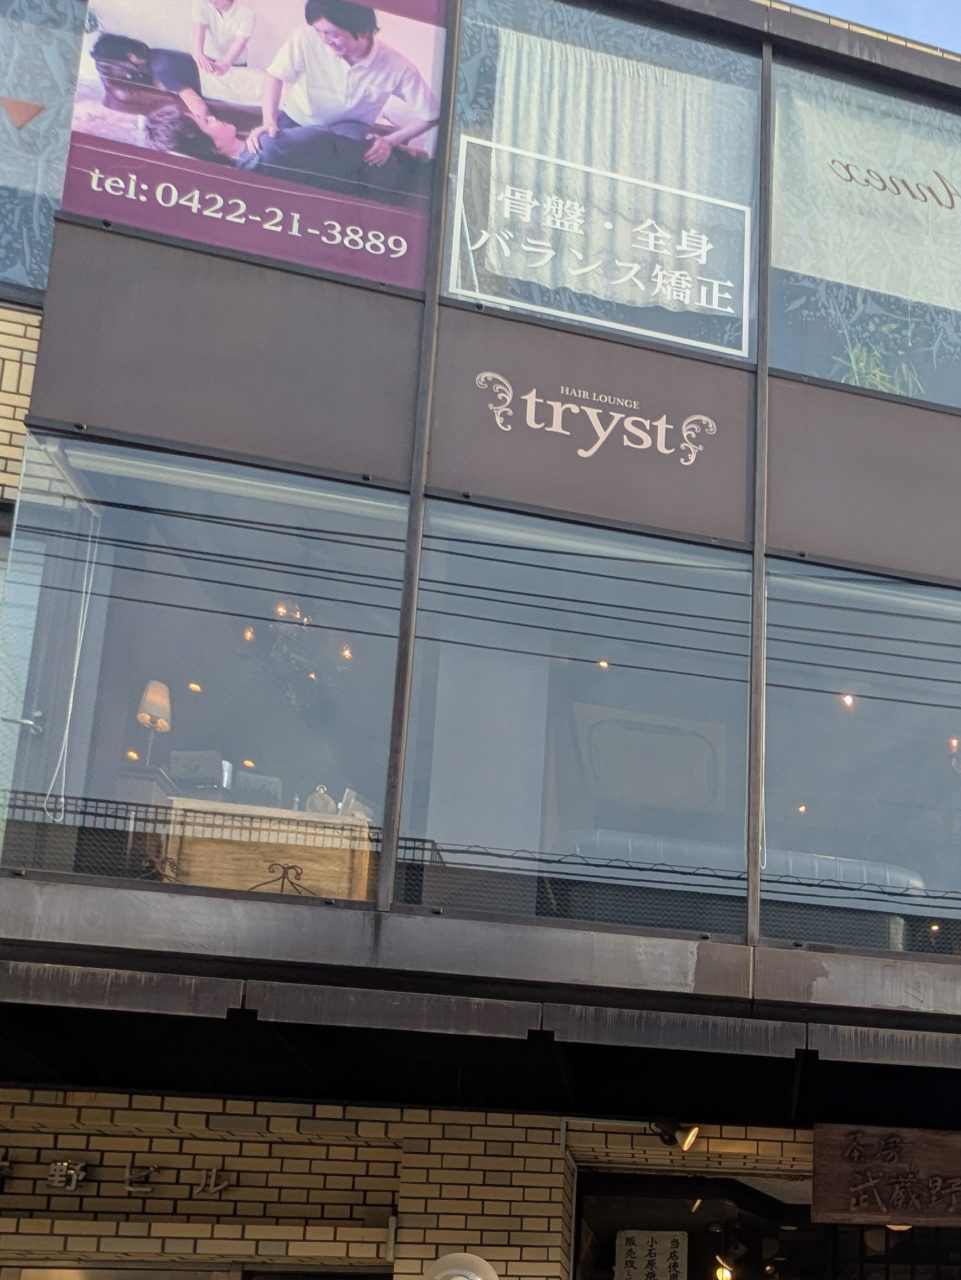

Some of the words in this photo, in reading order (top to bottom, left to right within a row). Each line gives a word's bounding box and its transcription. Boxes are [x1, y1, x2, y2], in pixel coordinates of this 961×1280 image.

[498, 185, 714, 265] 骨盤・全身
[470, 230, 736, 314] バランス矯正
[520, 388, 676, 458] tryst
[560, 385, 590, 400] HAIR
[592, 392, 640, 409] LOUNGE
